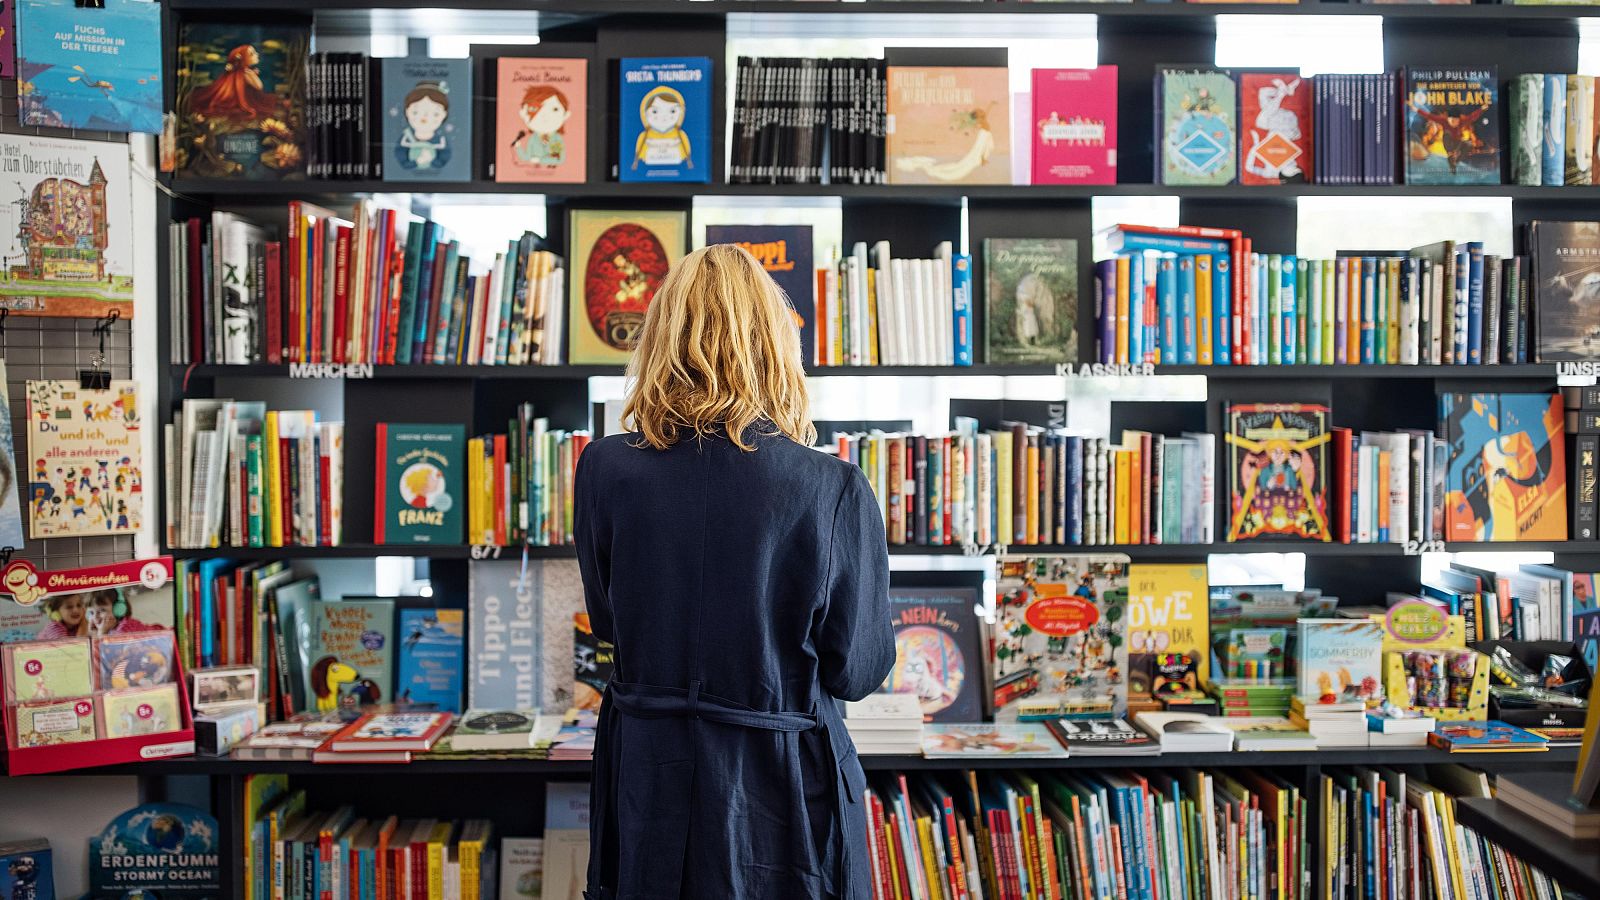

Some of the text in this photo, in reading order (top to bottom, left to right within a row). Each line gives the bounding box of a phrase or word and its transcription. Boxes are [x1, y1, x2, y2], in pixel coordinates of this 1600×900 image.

[74, 24, 105, 35] FUCHS
[54, 33, 125, 46] AUF MISSION IN
[61, 42, 119, 55] DER TIEFSEE
[1411, 71, 1490, 80] PHILIP PULLMAN
[1429, 82, 1466, 90] ABENTEUER
[1408, 91, 1492, 106] JOHN BLAKE
[4, 144, 21, 157] Hotel
[3, 158, 20, 173] zum
[735, 240, 787, 269] ippi
[1556, 247, 1600, 256] ARMSTR
[1055, 362, 1155, 378] KLASSIKER
[40, 421, 58, 432] Du
[60, 428, 104, 440] und ich
[106, 436, 129, 446] und
[45, 447, 120, 458] alle anderen
[1518, 485, 1540, 512] ELSA
[398, 509, 444, 527] FRANZ
[1519, 506, 1544, 535] NACHT
[471, 544, 502, 560] 6/7
[1401, 540, 1445, 556] 12/13
[48, 571, 130, 588] Ohrwürmchen
[1394, 623, 1439, 635] PERLEN
[478, 596, 506, 685] Tippo
[1172, 628, 1194, 644] DIR
[1309, 647, 1375, 659] SOMMERBY
[510, 655, 532, 710] und
[101, 855, 219, 868] ERDENFLUMM
[113, 870, 212, 881] STORMY OCEAN
